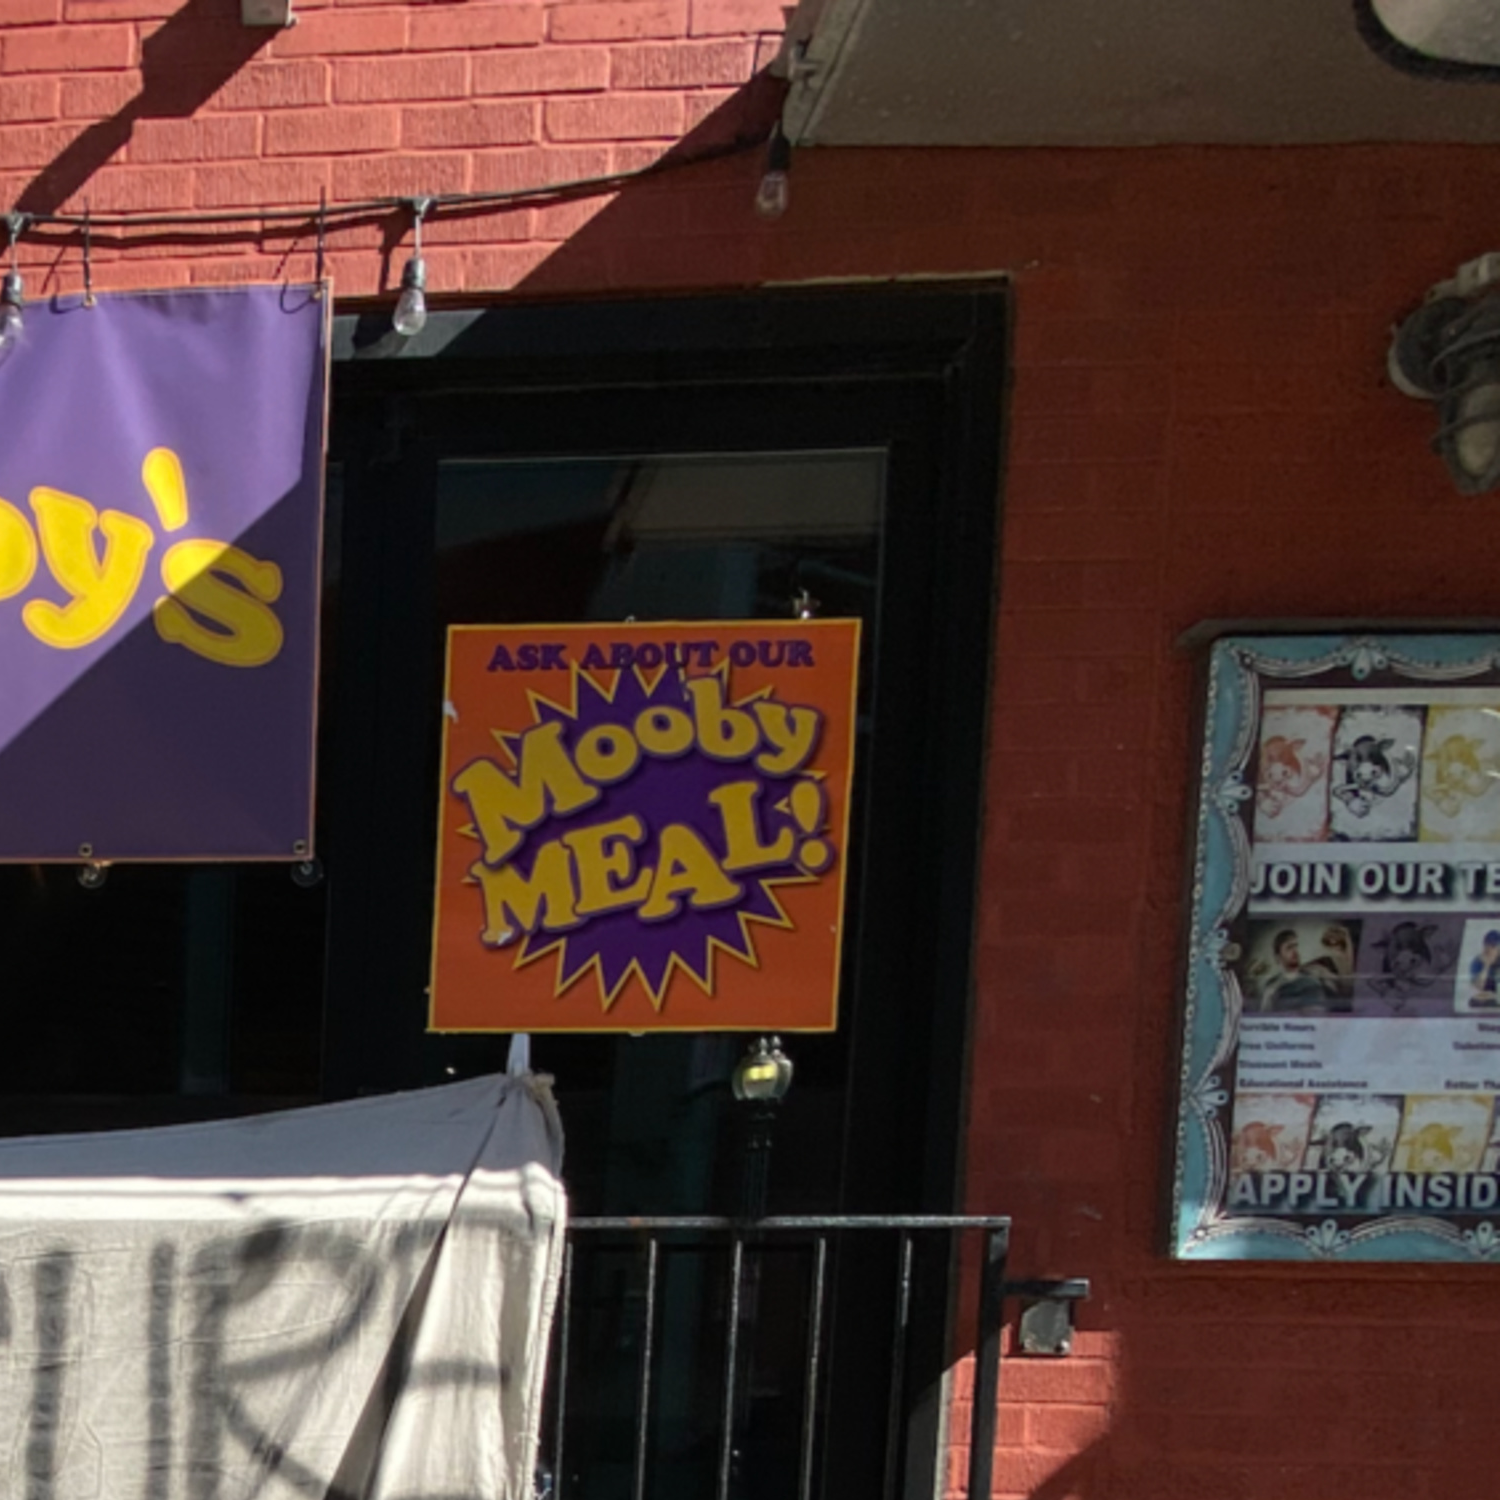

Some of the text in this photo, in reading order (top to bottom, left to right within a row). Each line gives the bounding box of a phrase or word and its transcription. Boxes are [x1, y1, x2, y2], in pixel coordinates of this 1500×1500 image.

[487, 640, 814, 672] ASK ABOUT OUR
[452, 675, 822, 866] Mooby
[470, 779, 834, 947] MEAL!
[1250, 862, 1343, 894] JOIN
[1356, 862, 1445, 894] OUR
[1235, 1173, 1368, 1207] APPLY
